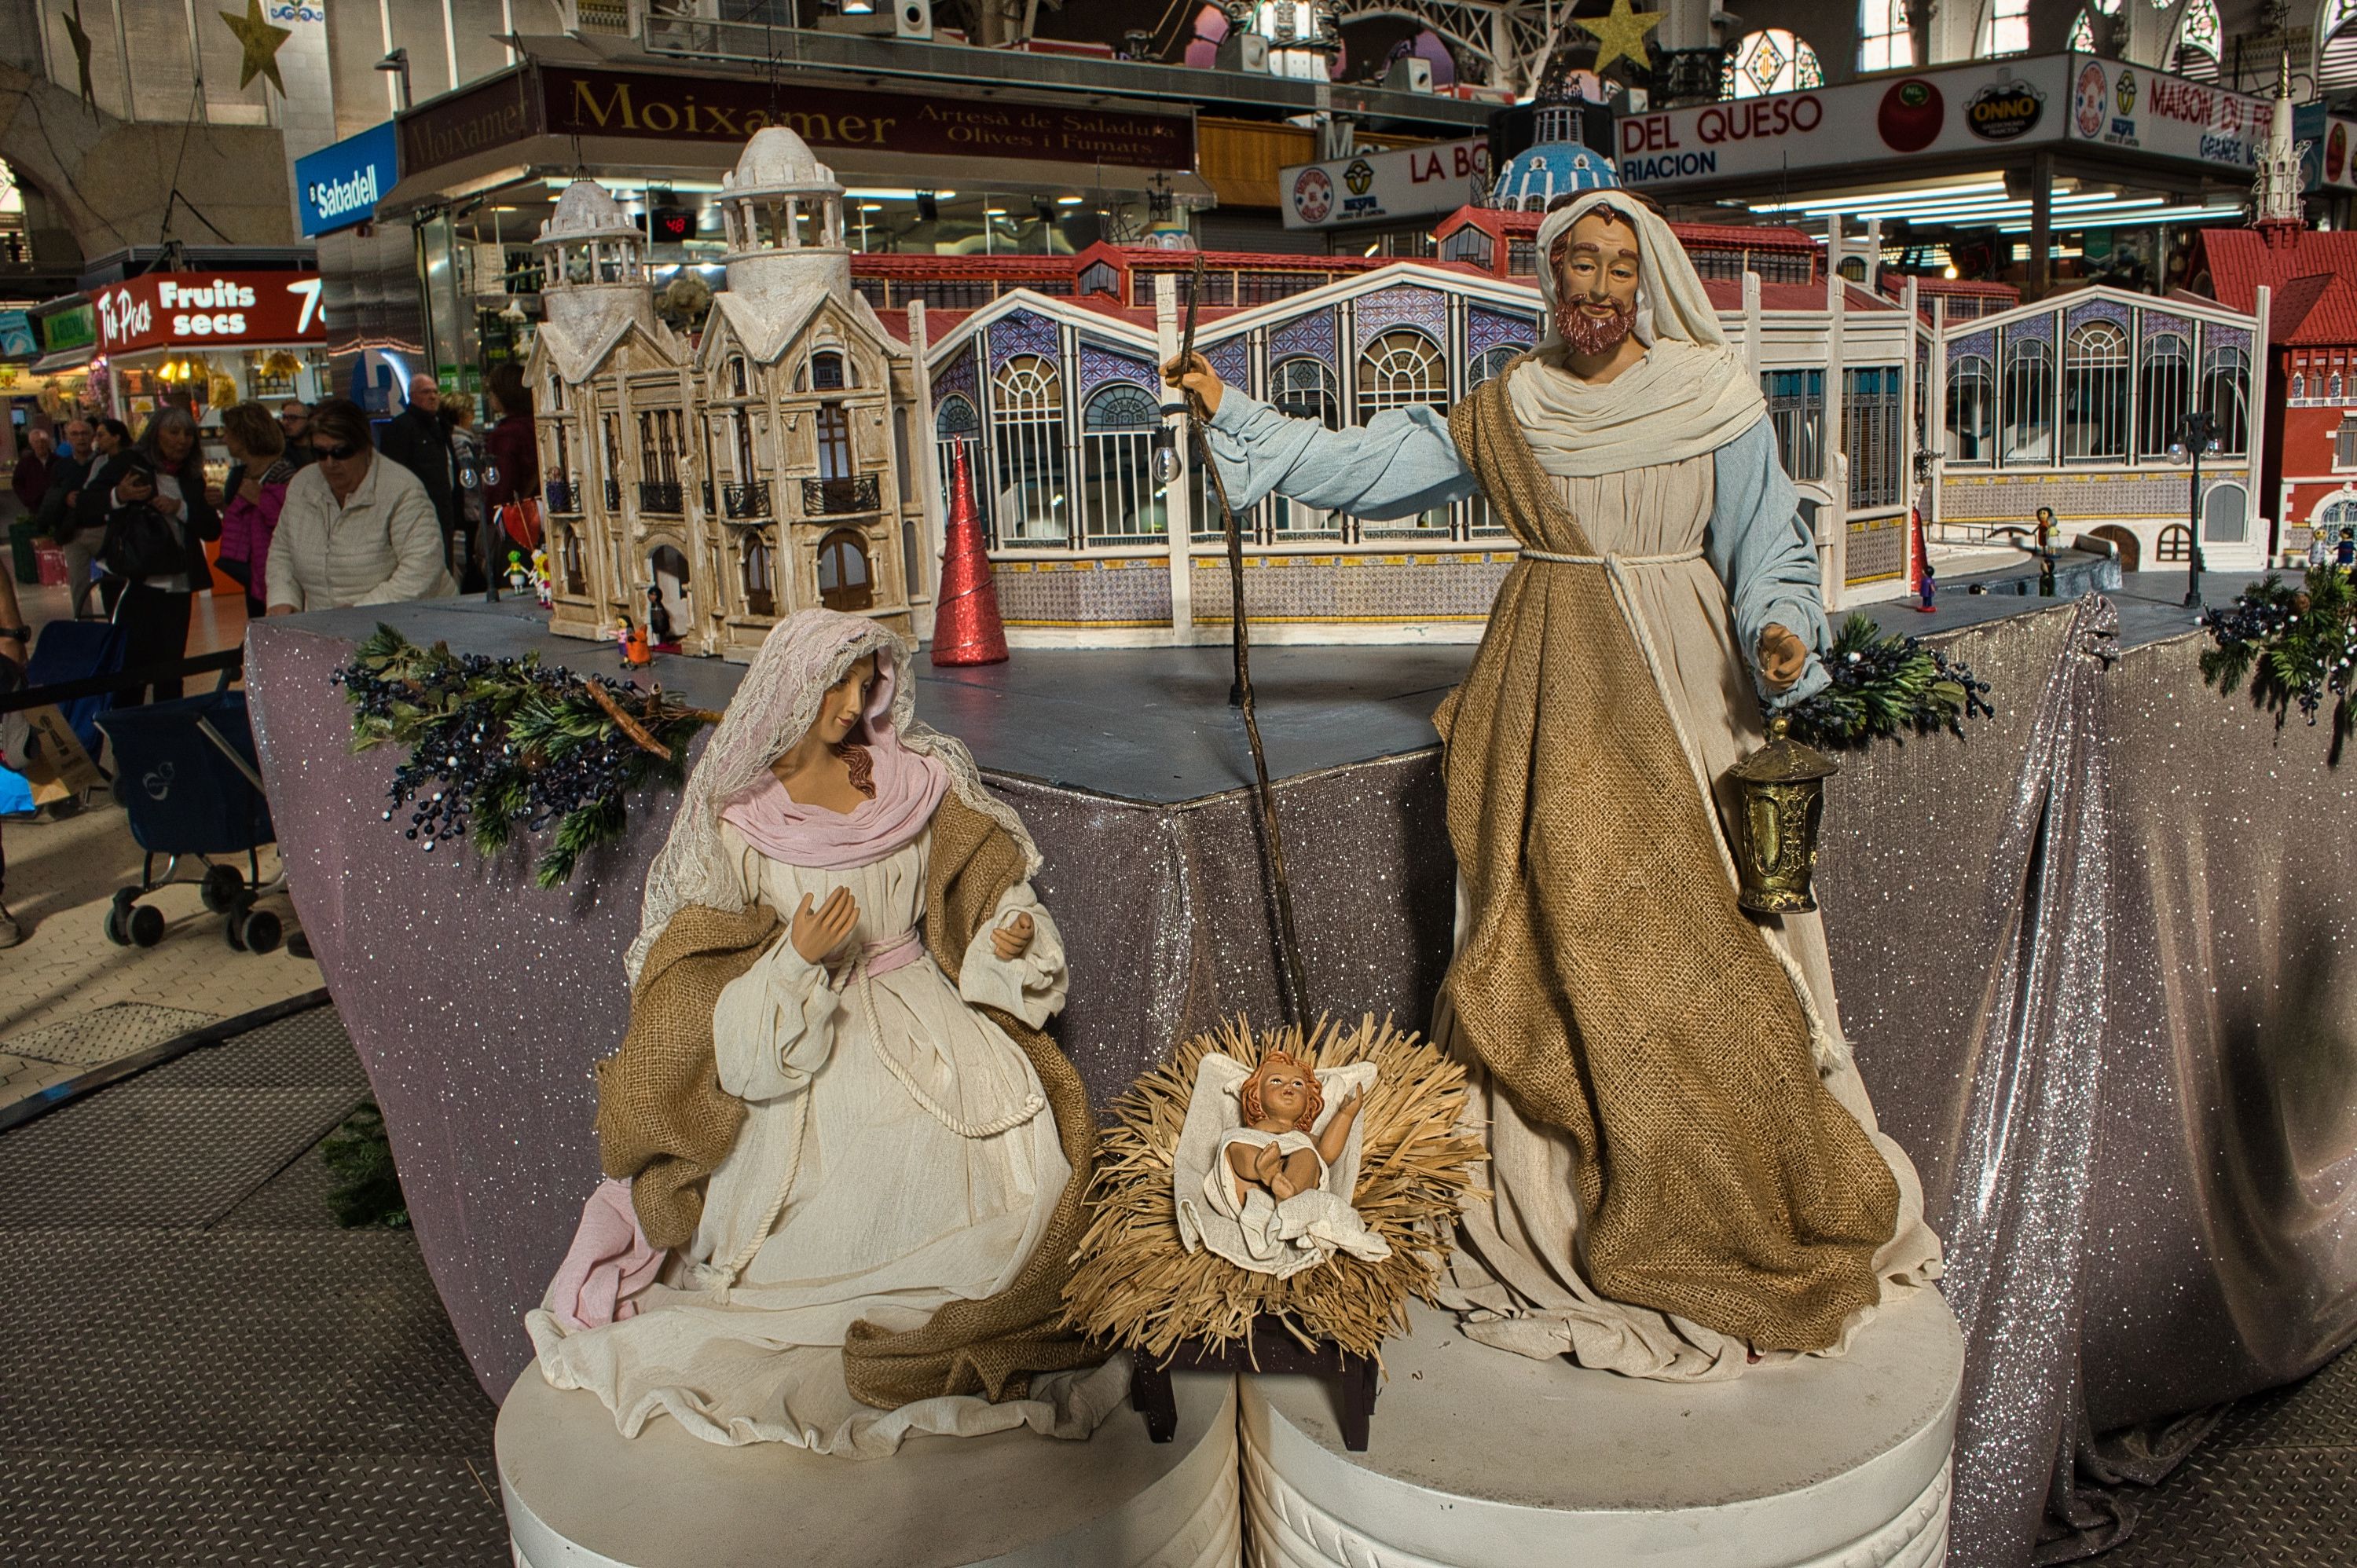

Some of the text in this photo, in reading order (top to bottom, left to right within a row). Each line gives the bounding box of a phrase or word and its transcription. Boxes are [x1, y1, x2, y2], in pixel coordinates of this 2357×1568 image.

[572, 80, 896, 145] Moixamer
[917, 104, 1010, 126] Artesà
[1021, 112, 1051, 129] de
[1974, 96, 2036, 123] ONNO
[2149, 78, 2214, 127] MAISON
[2220, 96, 2245, 133] DU
[947, 126, 1033, 147] Olives
[1062, 134, 1153, 155] Fumats
[1622, 95, 1823, 154] DEL QUESO
[1409, 151, 1446, 184] LA
[1623, 150, 1716, 183] RIACION
[317, 163, 378, 220] Sabadell
[665, 217, 686, 233] 48
[158, 278, 256, 309] Fruits
[117, 287, 152, 345] Paco
[173, 313, 247, 335] secs
